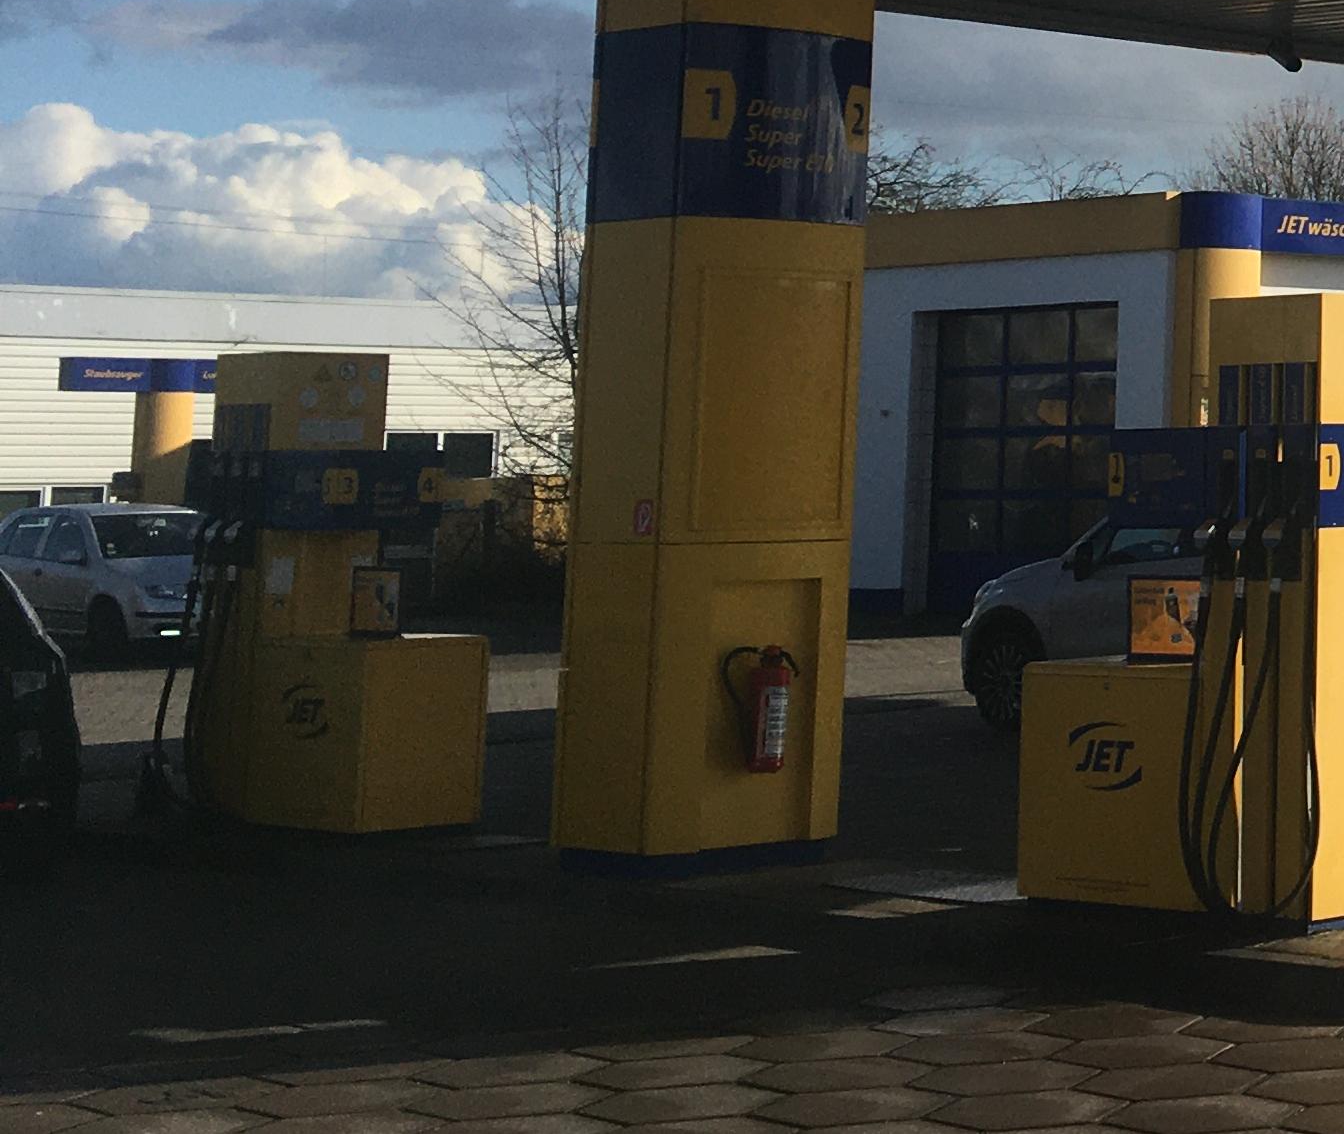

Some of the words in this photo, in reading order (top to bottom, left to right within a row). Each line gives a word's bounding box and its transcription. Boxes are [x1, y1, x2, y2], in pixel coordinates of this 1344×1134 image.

[705, 87, 722, 121] 1
[747, 99, 809, 122] Diesel
[851, 103, 865, 135] 2
[745, 124, 802, 147] Super
[745, 150, 802, 173] Super
[1325, 454, 1333, 477] 1
[287, 699, 325, 723] JET
[1075, 739, 1136, 773] JET
